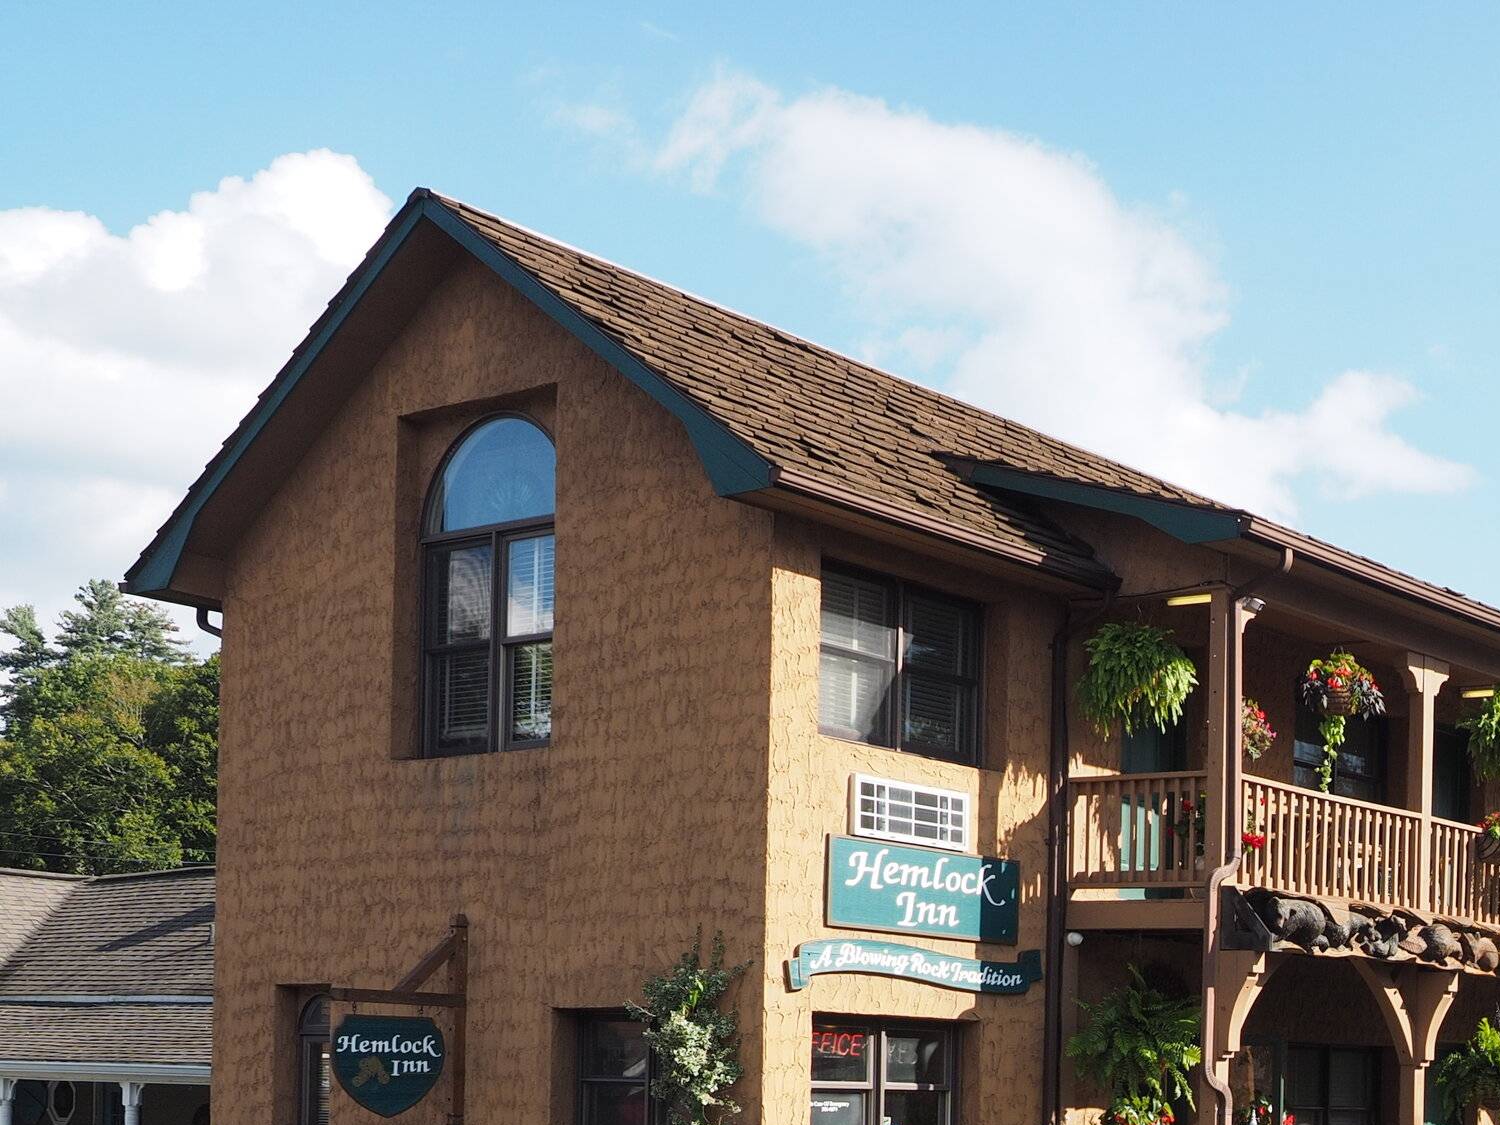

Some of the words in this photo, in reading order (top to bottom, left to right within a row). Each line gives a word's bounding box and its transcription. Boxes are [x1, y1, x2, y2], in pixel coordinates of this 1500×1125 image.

[845, 849, 1006, 906] Hemlock
[896, 891, 960, 927] Inn
[812, 945, 832, 969] A
[837, 943, 909, 974] Blowing
[950, 963, 1022, 987] Tradition
[336, 1034, 442, 1057] Hemlock
[391, 1060, 431, 1076] Inn
